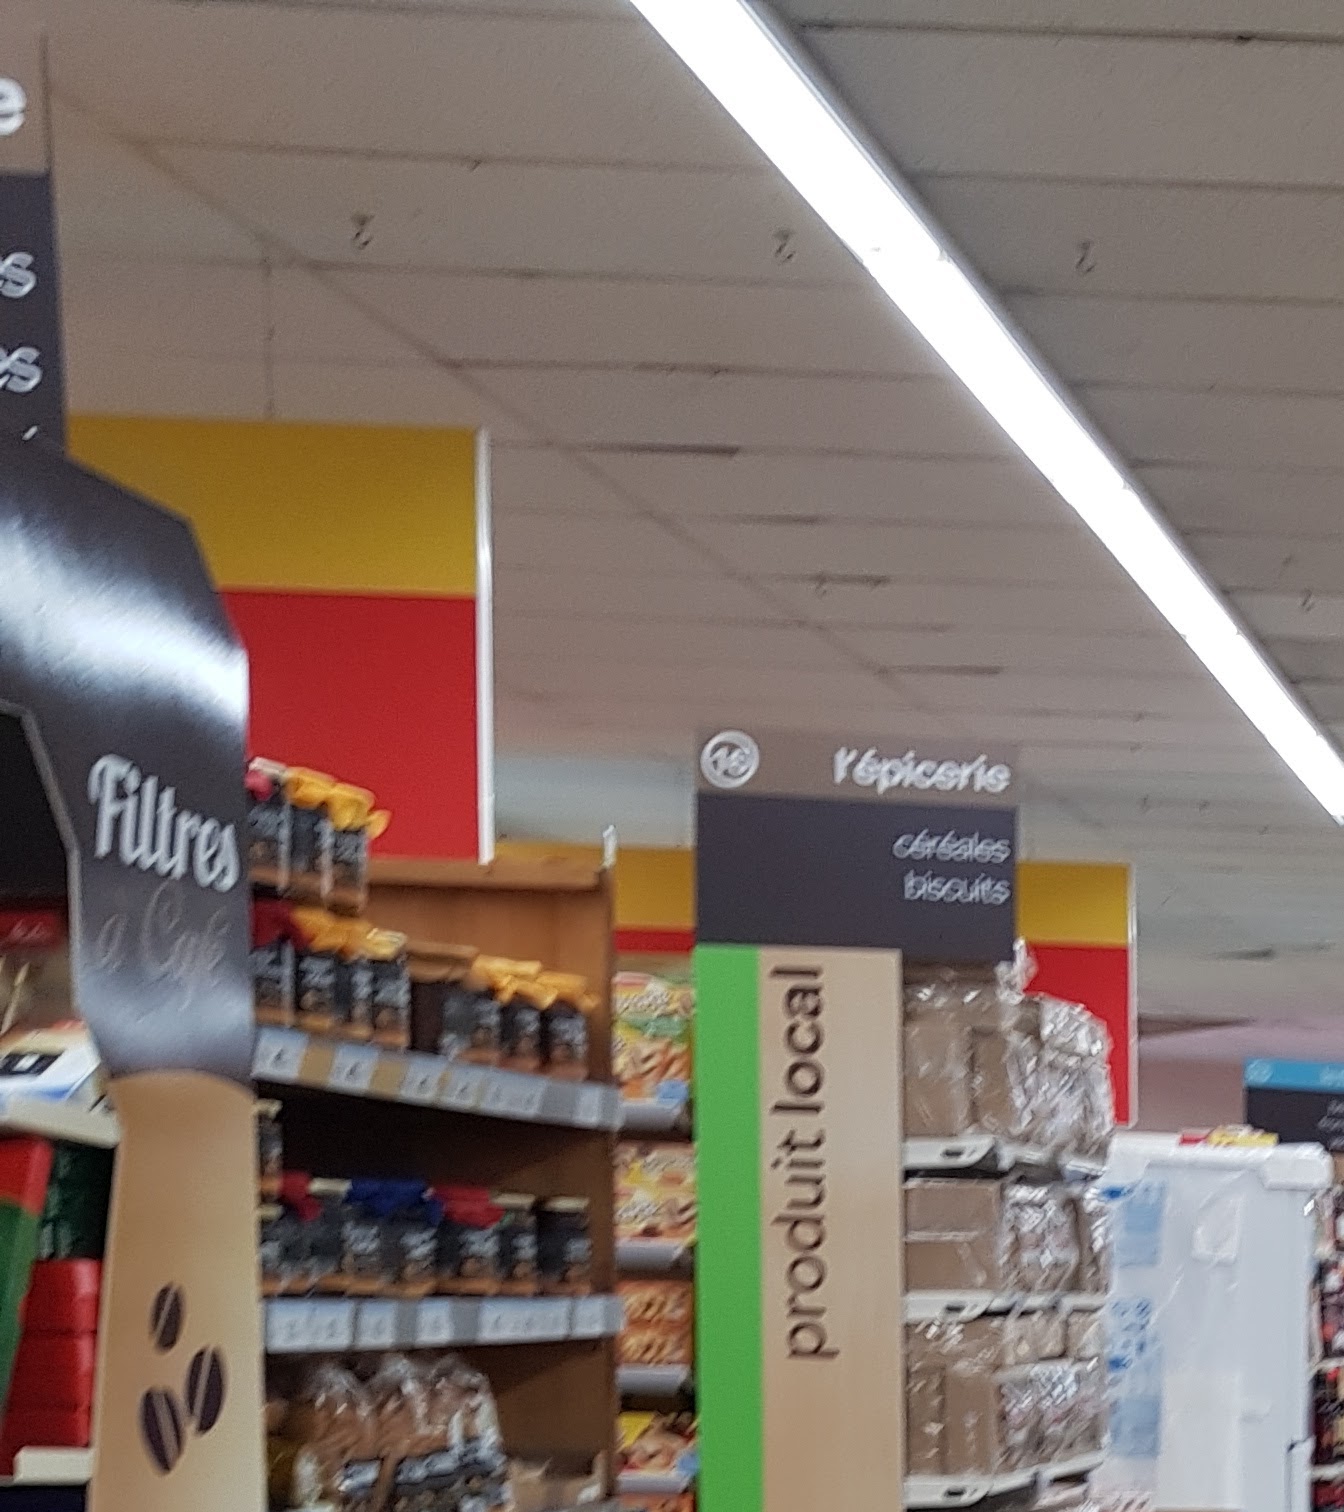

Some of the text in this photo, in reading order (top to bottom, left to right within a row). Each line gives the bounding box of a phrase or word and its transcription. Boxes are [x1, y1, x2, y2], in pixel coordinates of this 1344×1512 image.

[87, 753, 241, 893] Filtres
[903, 867, 1012, 905] biscuits
[769, 964, 841, 1360] produit local
